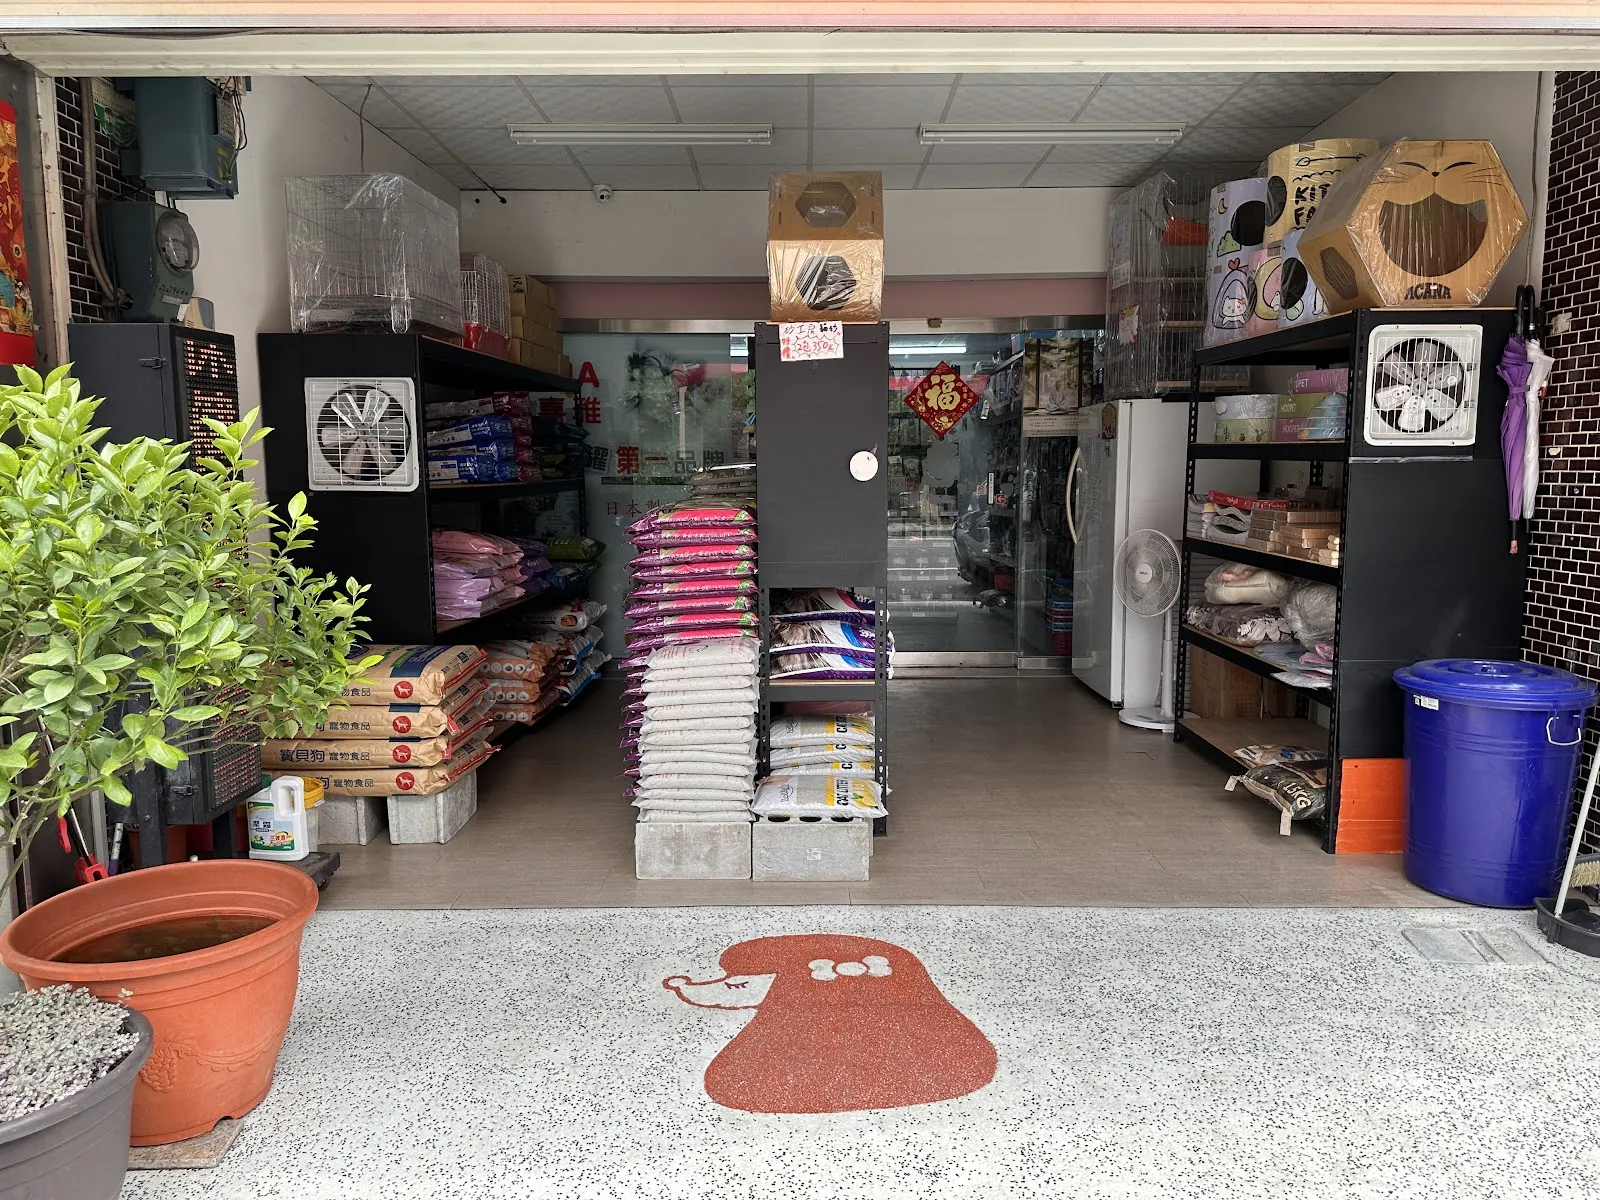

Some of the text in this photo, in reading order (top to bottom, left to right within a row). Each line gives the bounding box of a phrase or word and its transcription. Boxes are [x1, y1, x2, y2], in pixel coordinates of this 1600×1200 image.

[1404, 283, 1452, 300] ACANA
[924, 374, 961, 411] 福
[280, 749, 370, 762] 寶貝狗 寵物食品
[333, 779, 374, 788] 寵物食品
